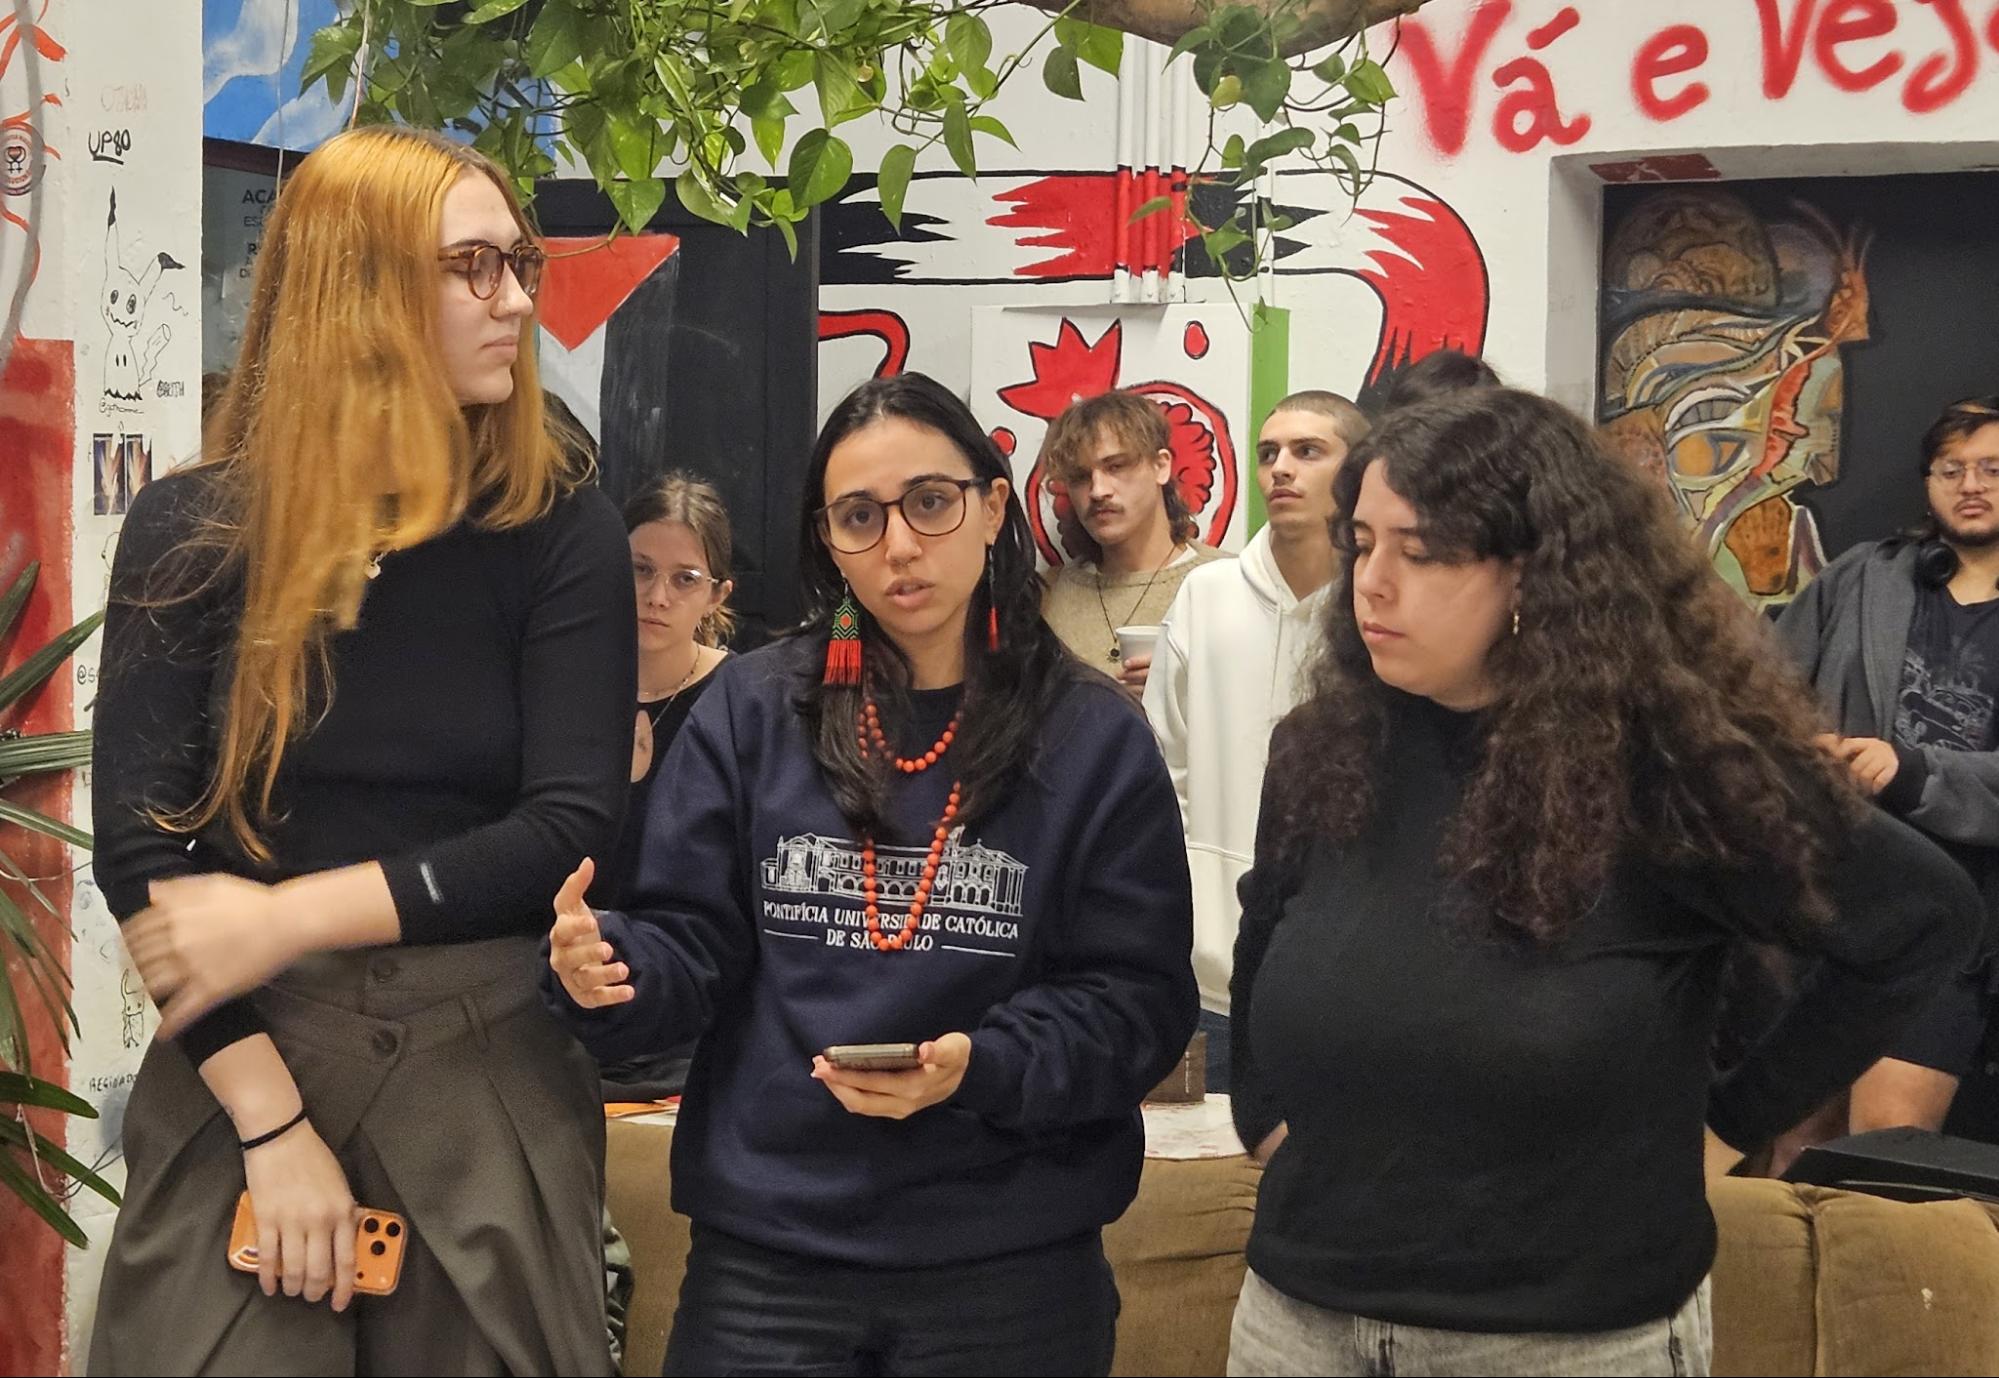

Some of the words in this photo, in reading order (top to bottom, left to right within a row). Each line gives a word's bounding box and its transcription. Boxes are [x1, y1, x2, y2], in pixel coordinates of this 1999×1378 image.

[1393, 0, 1591, 156] Vá
[1633, 25, 1710, 122] e
[1755, 0, 1999, 113] Vej
[763, 900, 828, 923] PONTIFÍCIA
[834, 907, 942, 930] UNIVRSIDDE
[944, 915, 1019, 939] CATÓLICA
[826, 928, 846, 947] DE
[887, 933, 934, 951] PULO
